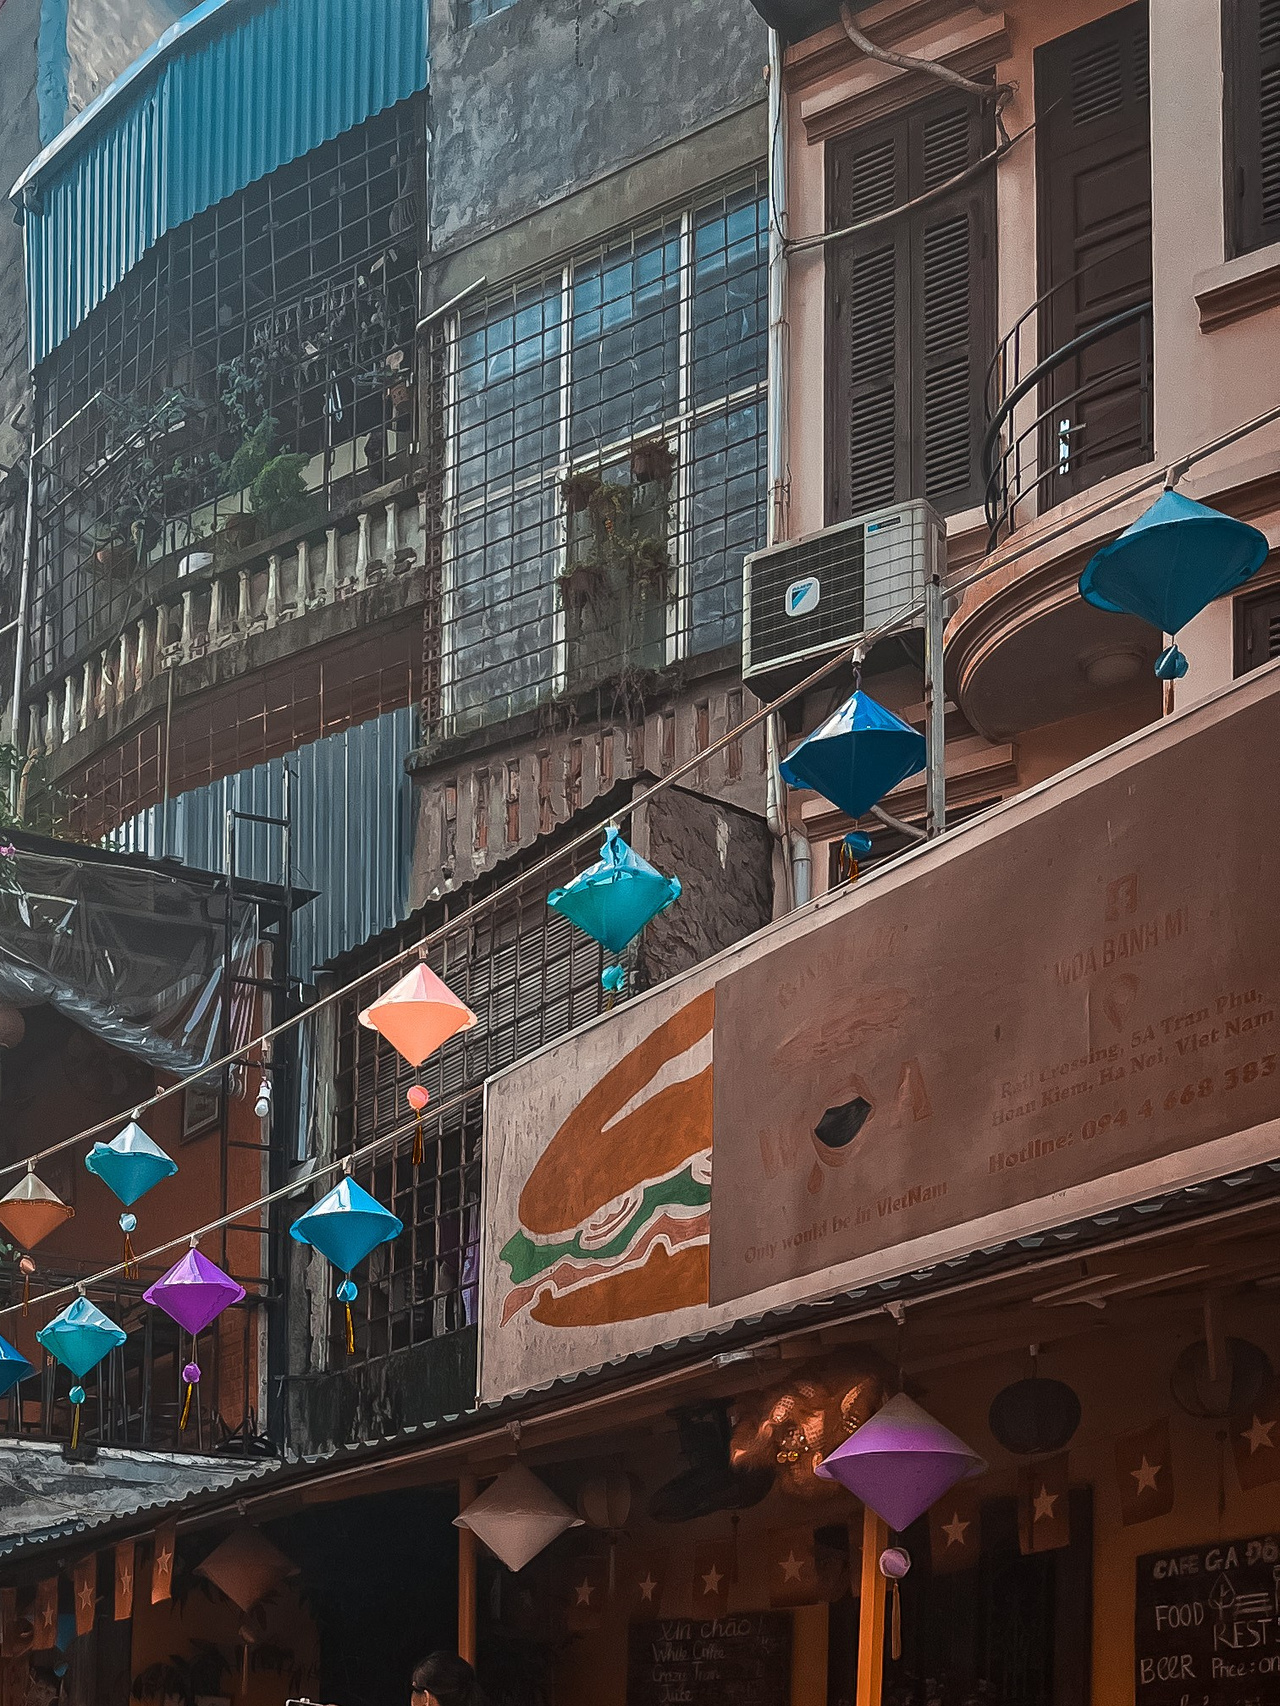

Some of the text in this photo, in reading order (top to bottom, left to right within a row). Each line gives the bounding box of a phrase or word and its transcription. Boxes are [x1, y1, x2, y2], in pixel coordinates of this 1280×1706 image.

[1131, 1022, 1156, 1049] 5A
[1175, 1027, 1220, 1058] Viet
[1223, 1009, 1275, 1039] Nam
[988, 1130, 1074, 1176] Hotline:
[1152, 1554, 1200, 1580] CAFE
[1205, 1546, 1240, 1573] GA
[1155, 1601, 1205, 1632] FOOD
[1213, 1618, 1274, 1652] REST
